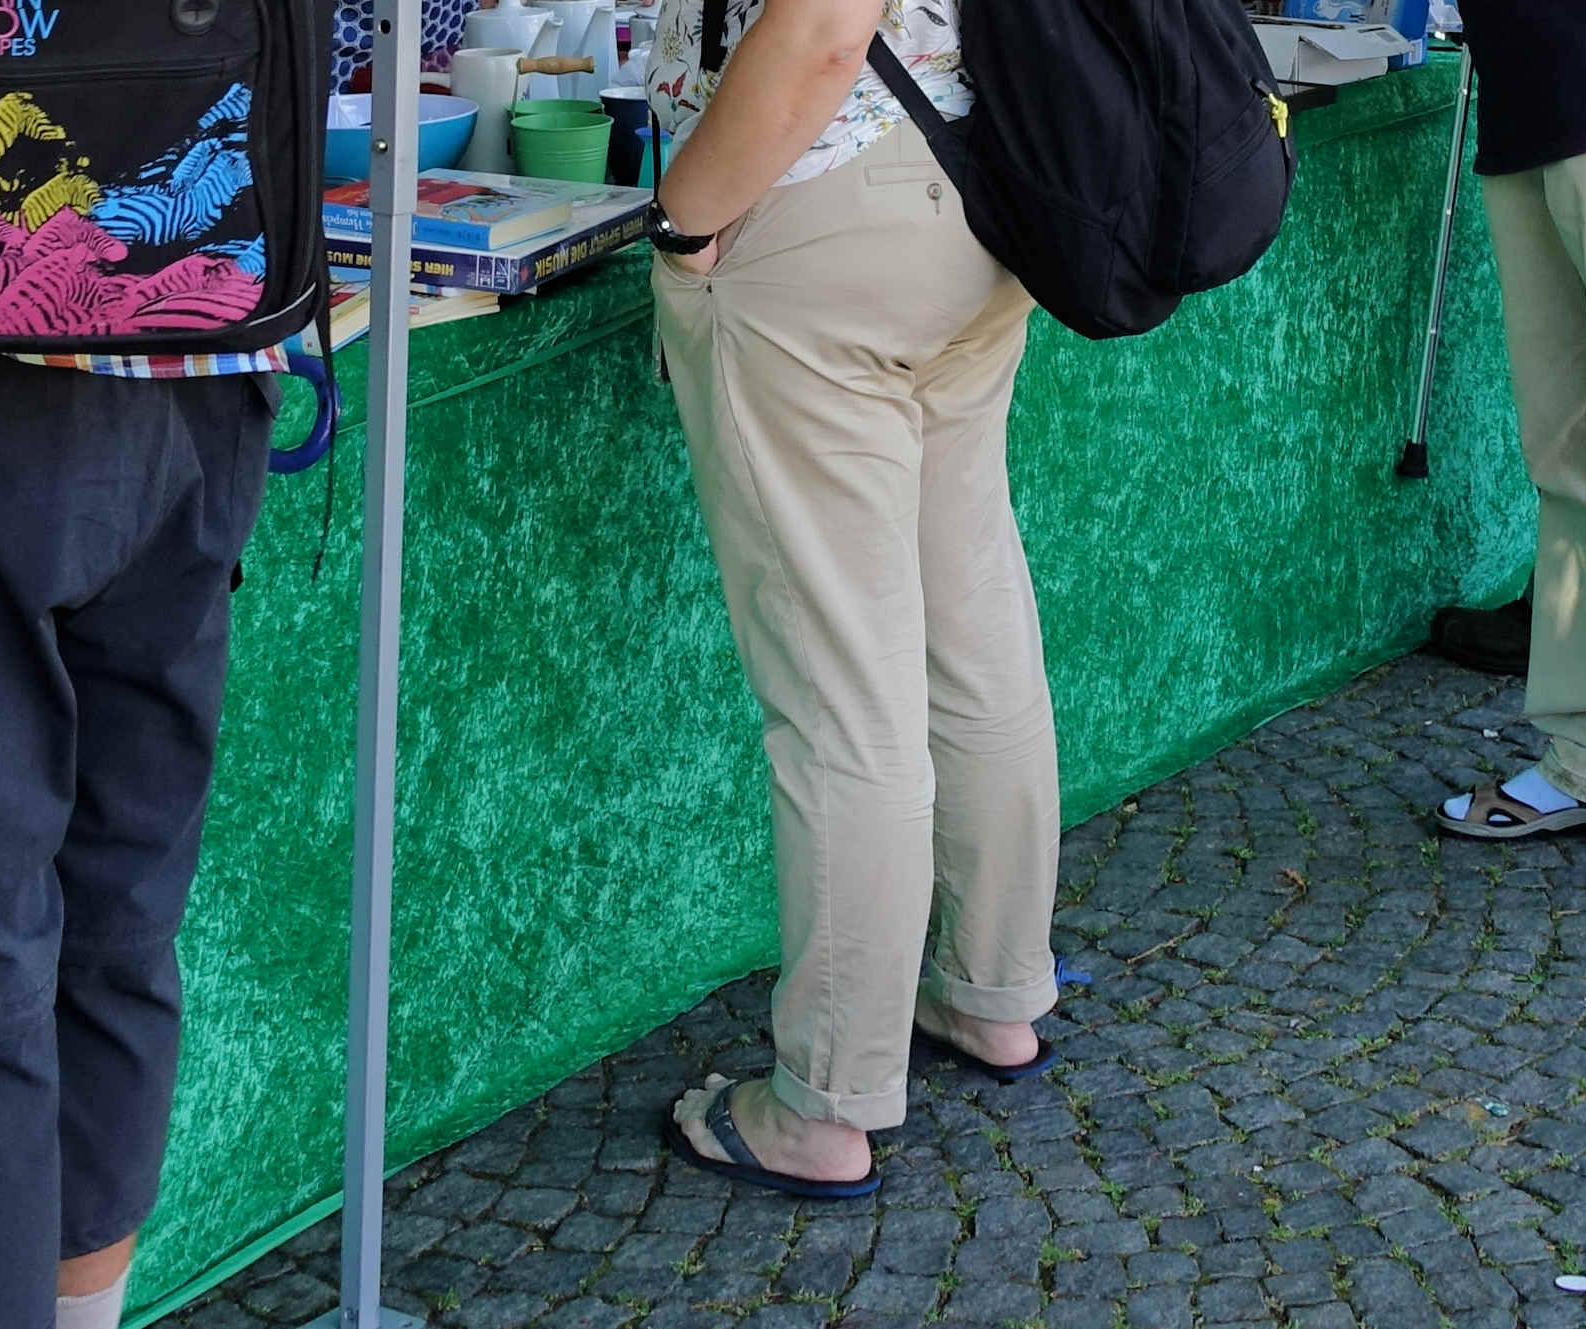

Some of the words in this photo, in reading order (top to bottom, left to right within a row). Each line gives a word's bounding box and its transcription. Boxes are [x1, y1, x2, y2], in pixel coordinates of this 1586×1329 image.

[534, 245, 570, 281] MUSIK
[571, 241, 588, 264] DIE
[424, 261, 455, 277] HIER
